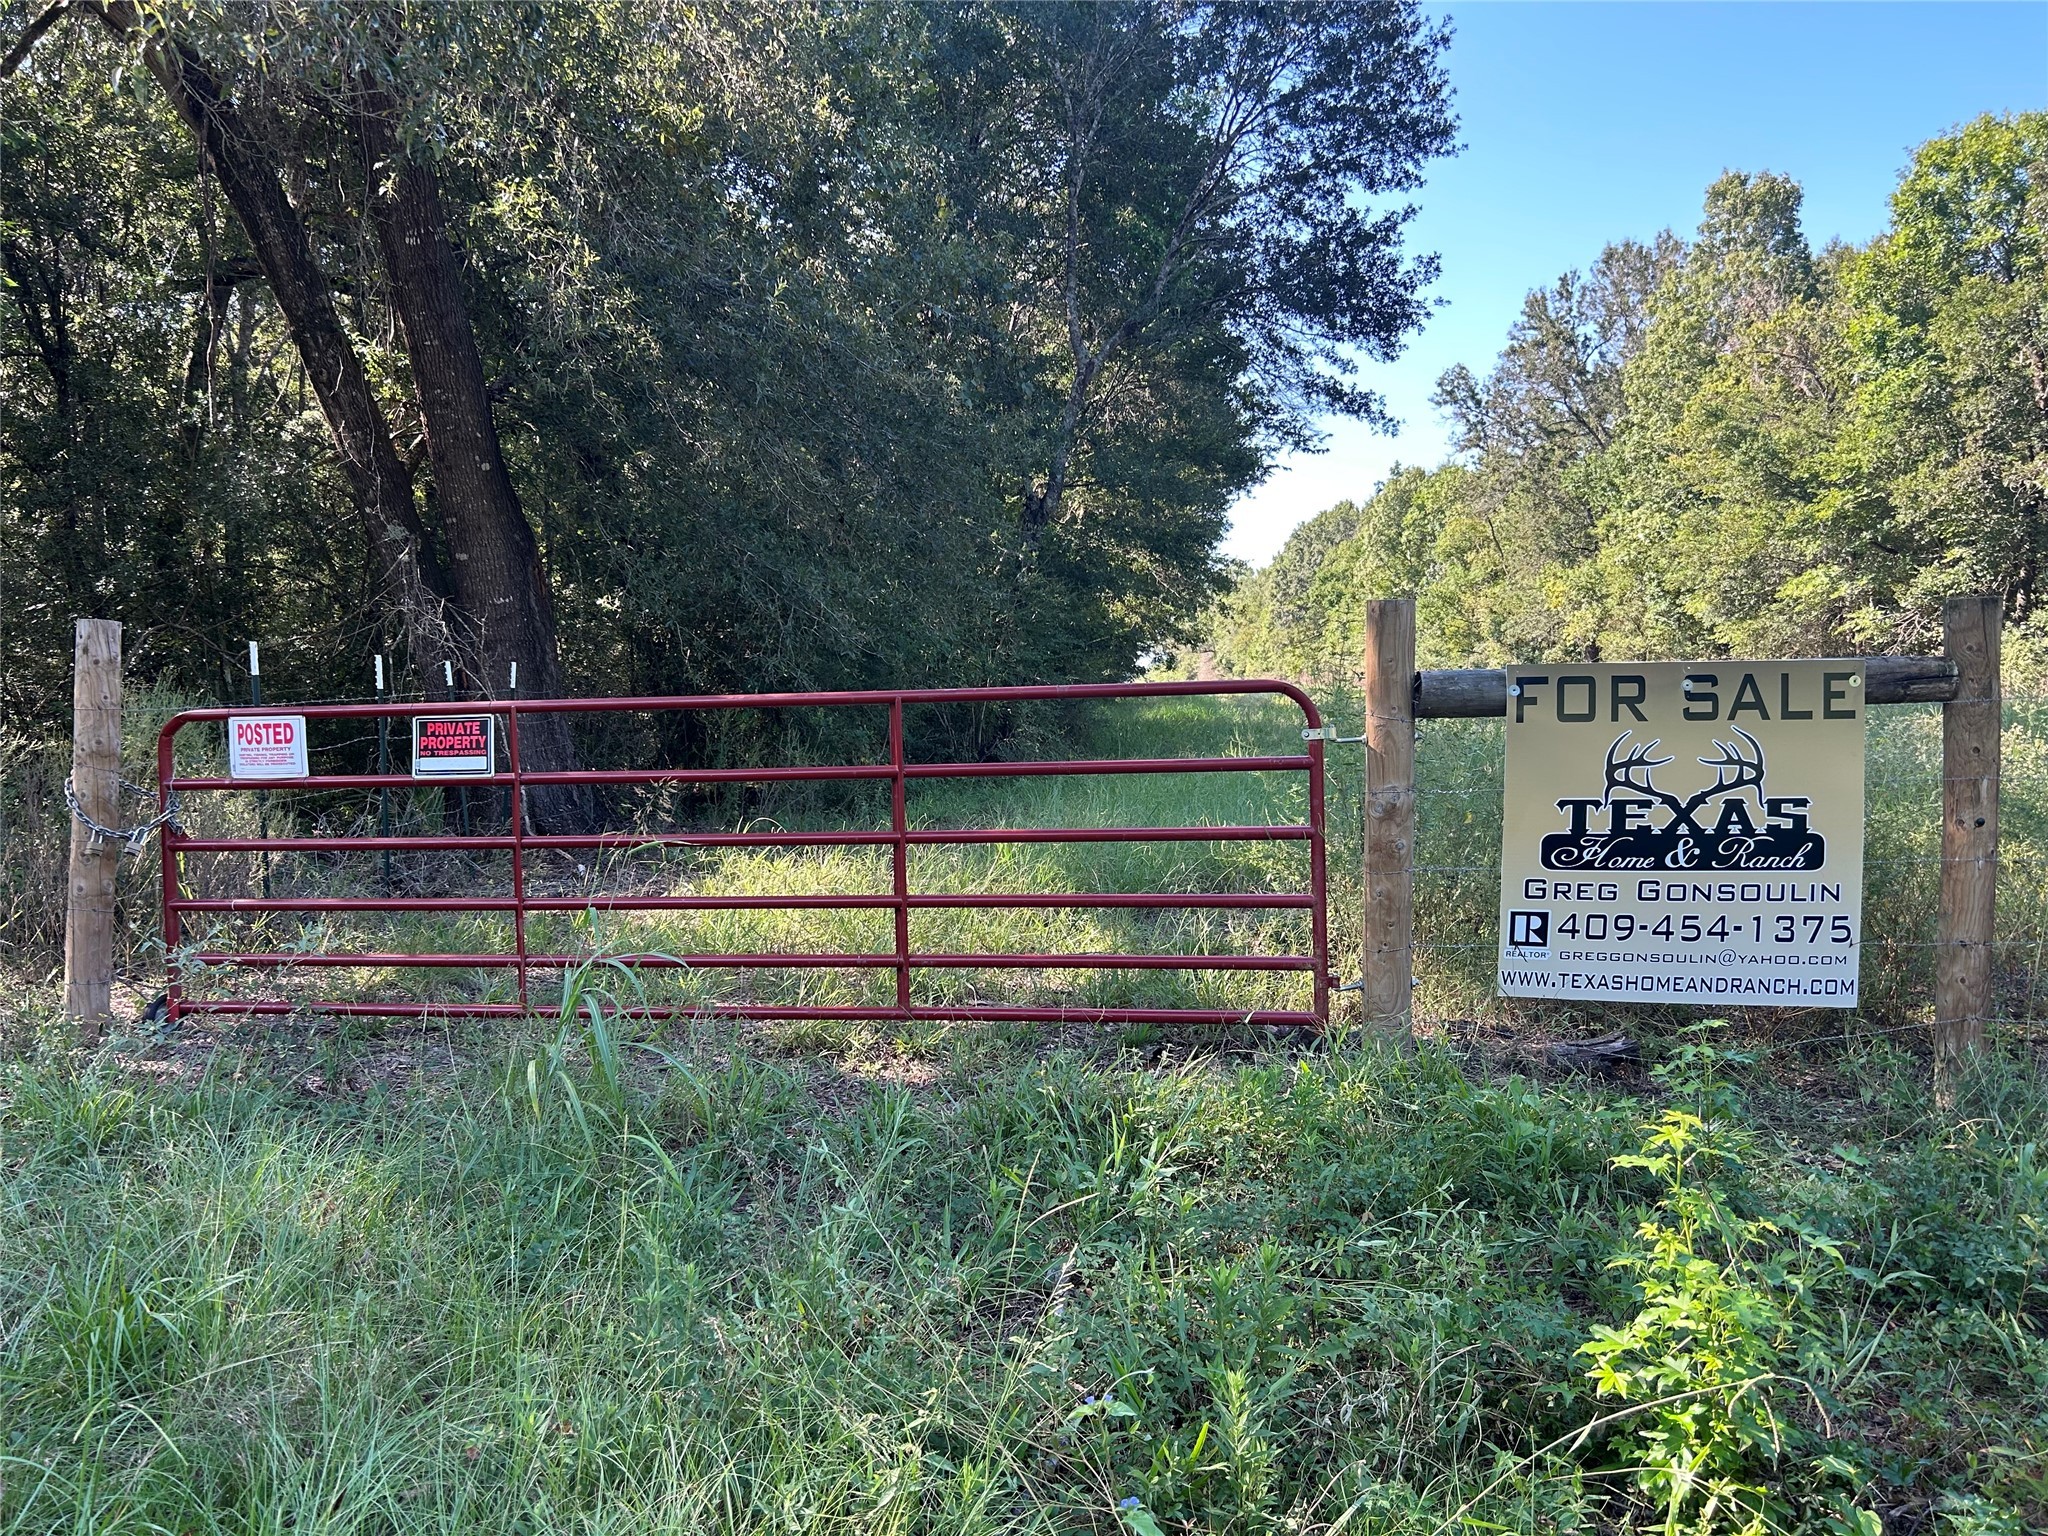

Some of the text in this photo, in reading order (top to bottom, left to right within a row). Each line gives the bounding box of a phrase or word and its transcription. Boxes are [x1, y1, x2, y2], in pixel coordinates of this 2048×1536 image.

[1515, 672, 1857, 723] FOR SALE
[237, 723, 294, 745] POSTED
[427, 722, 481, 735] PRIVATE
[420, 736, 487, 749] PROPERTY
[1555, 797, 1813, 834] TEXAS
[1550, 836, 1813, 869] Home & Ranch
[1523, 878, 1842, 902] GREG GONSOULIN
[1557, 912, 1852, 943] 409-454-1375
[1559, 949, 1848, 966] GREGGONSOULIN@YAHOO.COM
[1501, 970, 1856, 996] WWW.TEXASHOMEANDRANCH.COM
